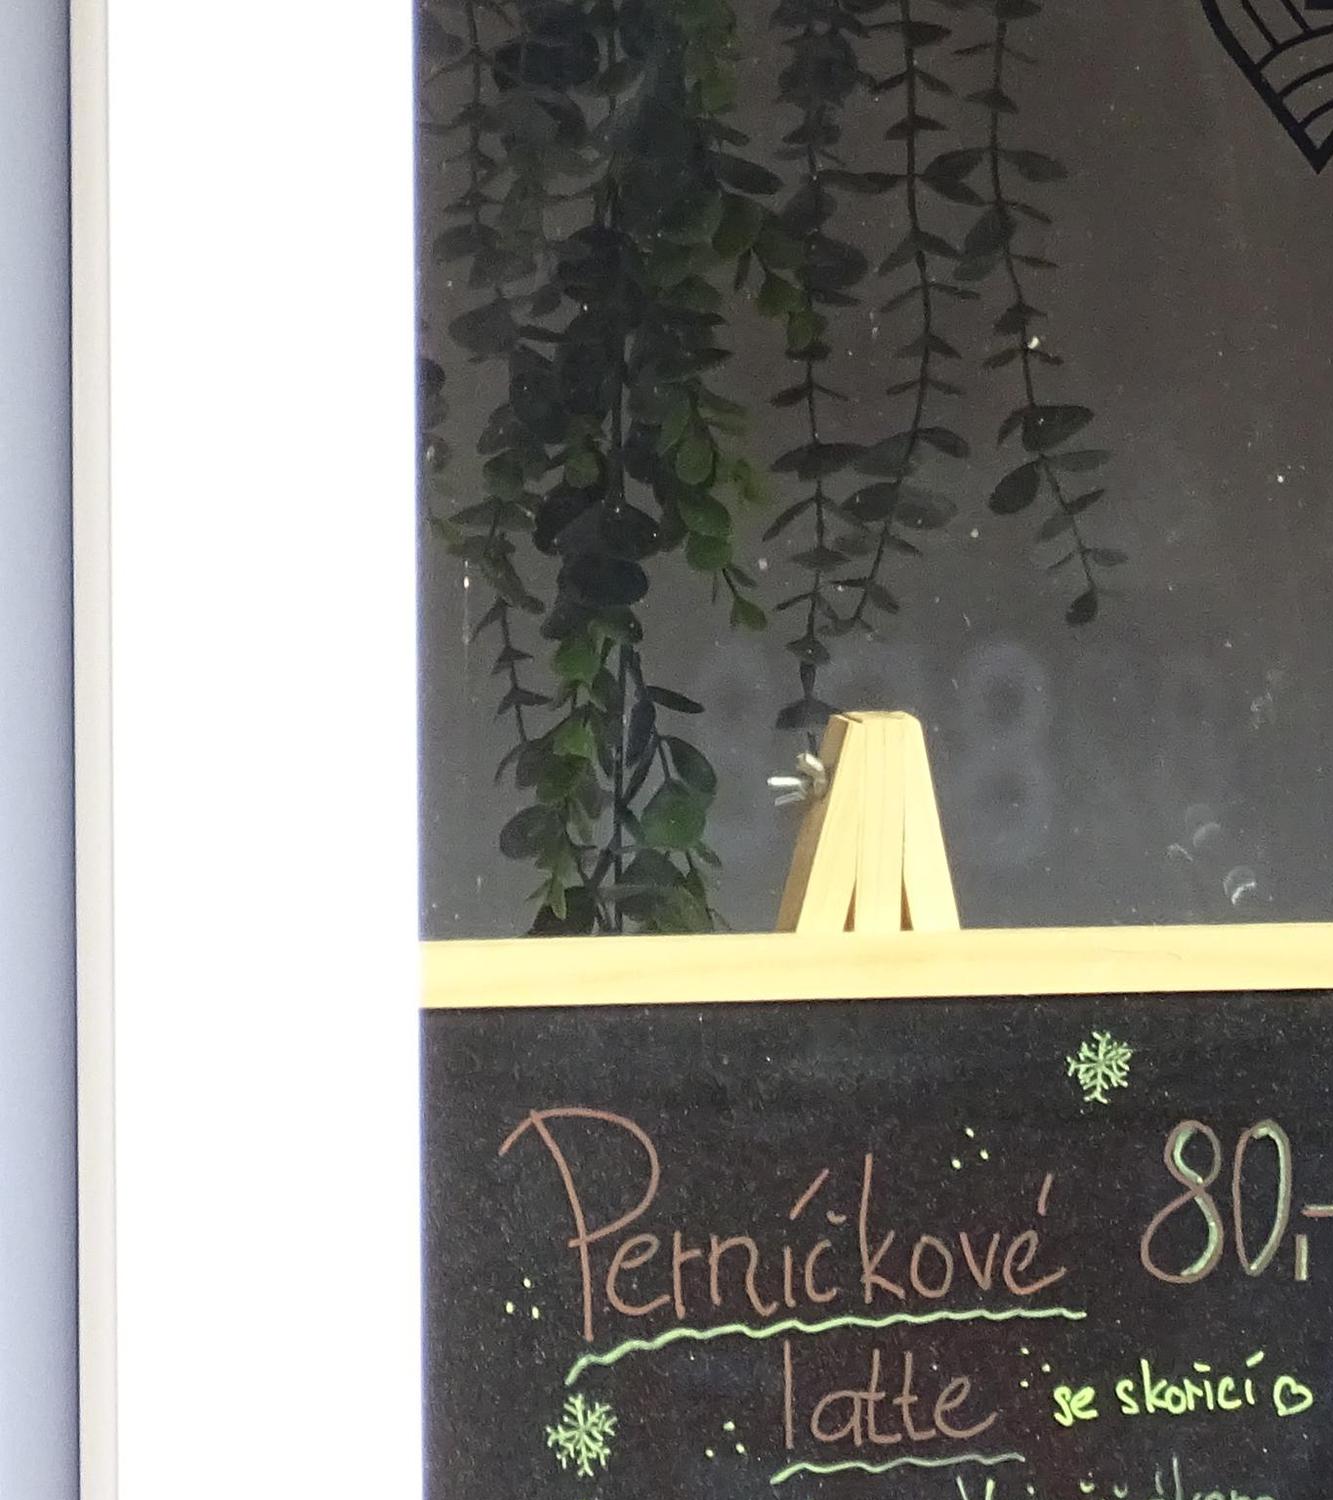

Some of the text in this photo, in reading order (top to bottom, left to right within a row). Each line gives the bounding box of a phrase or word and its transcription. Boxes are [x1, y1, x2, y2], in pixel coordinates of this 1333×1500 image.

[500, 1108, 1067, 1342] Perníčkové
[782, 1339, 999, 1451] latte
[1053, 1385, 1098, 1427] se
